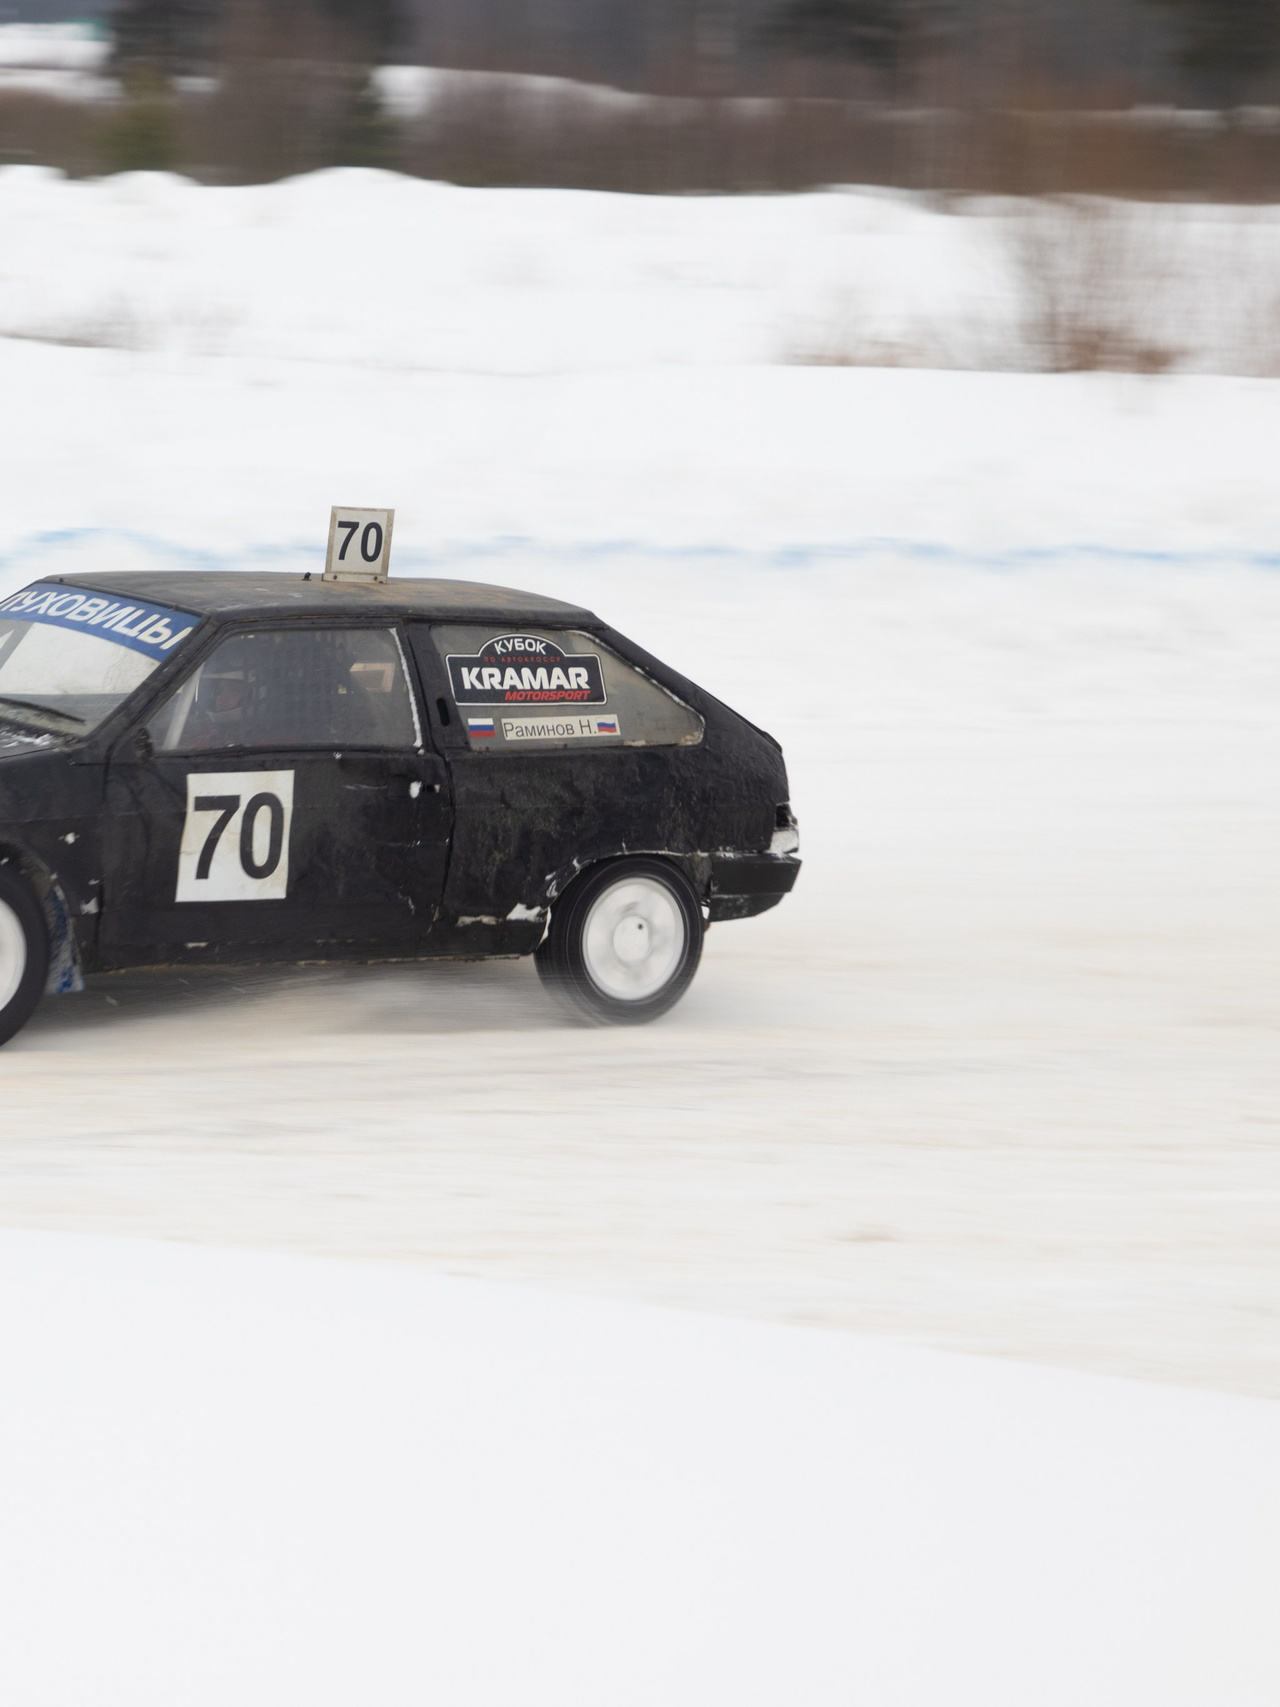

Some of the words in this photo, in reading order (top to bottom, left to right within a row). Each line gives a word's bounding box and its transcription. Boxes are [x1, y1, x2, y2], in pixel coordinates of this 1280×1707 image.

[337, 520, 384, 563] 70
[494, 638, 546, 655] КУБОК
[461, 667, 591, 690] KRAMAR
[504, 690, 591, 701] MOTORSPORT
[503, 722, 575, 738] Раминов
[579, 719, 597, 735] Н.
[194, 791, 285, 880] 70
